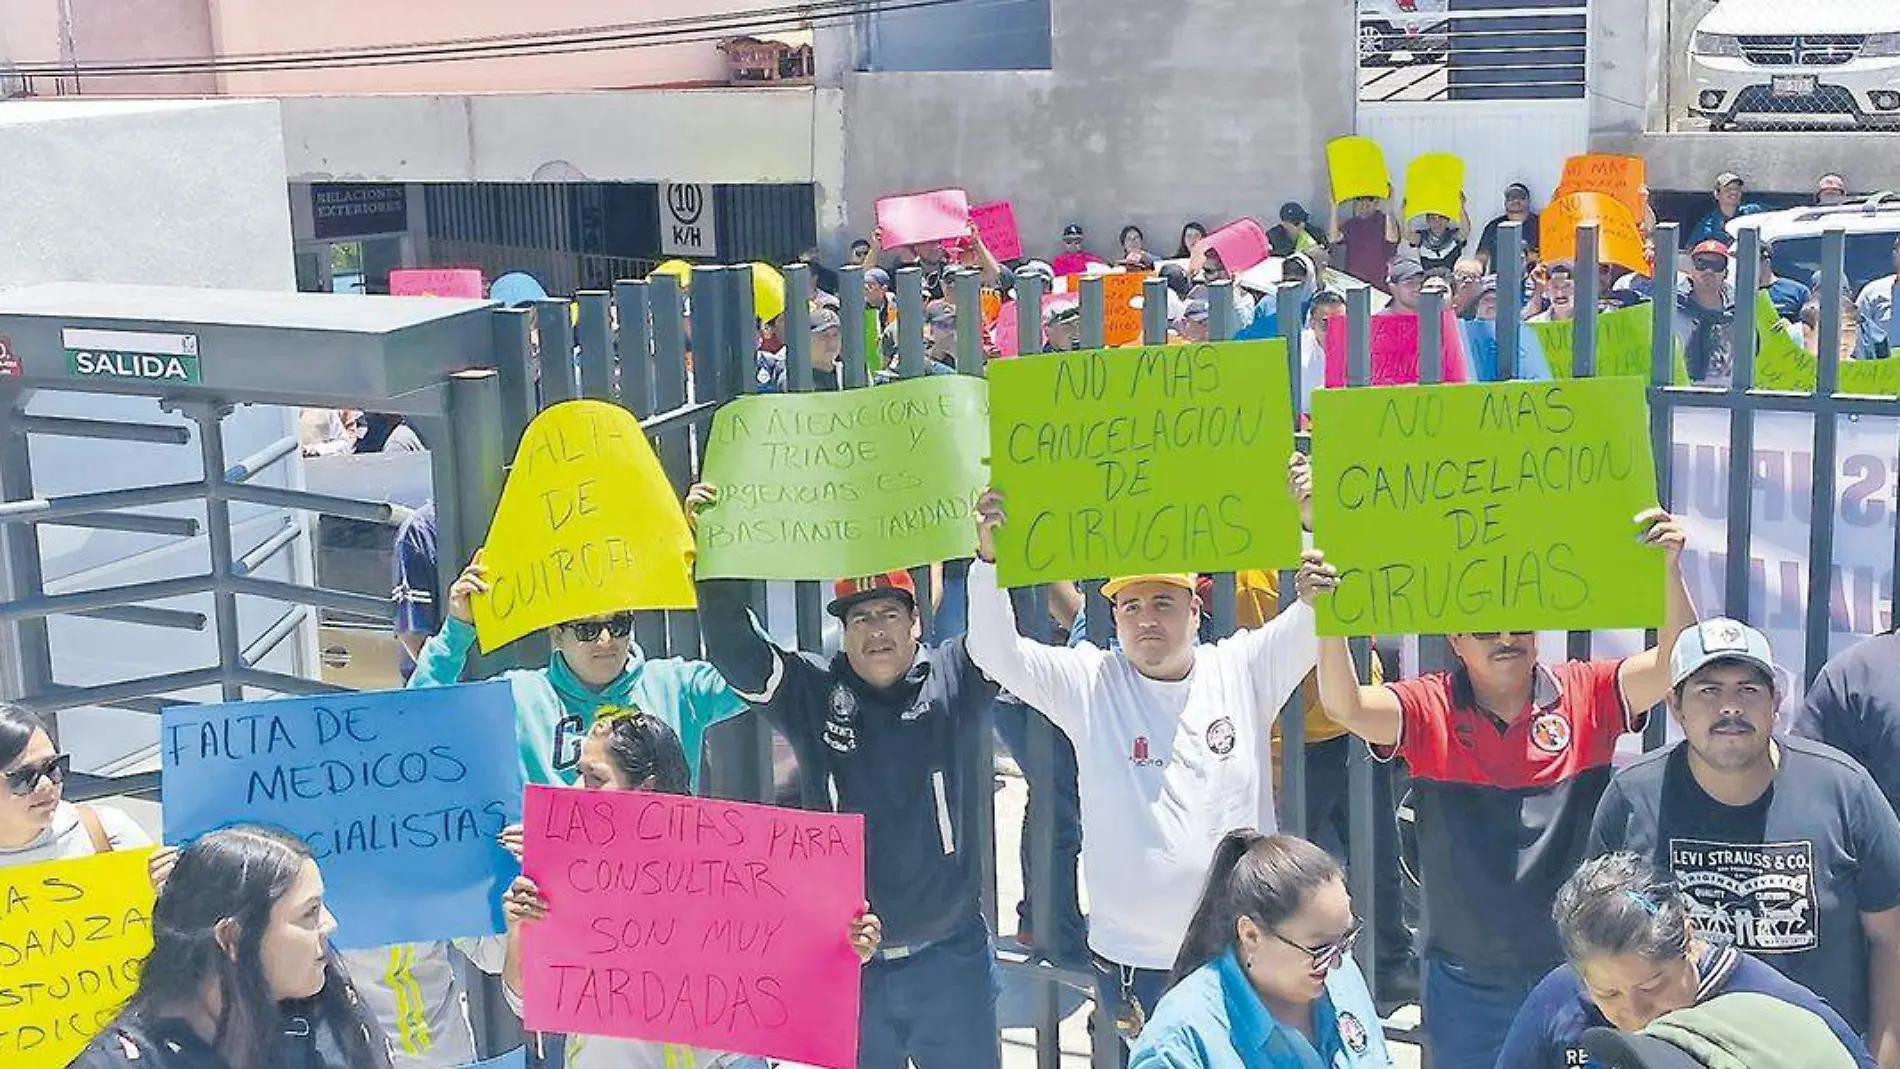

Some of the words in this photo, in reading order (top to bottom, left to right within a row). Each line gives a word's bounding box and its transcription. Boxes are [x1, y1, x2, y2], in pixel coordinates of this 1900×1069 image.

[674, 183, 694, 212] 10
[672, 225, 701, 247] K/H
[76, 351, 188, 380] SALIDA
[1053, 351, 1108, 405] NO
[1129, 344, 1222, 399] MAS
[716, 413, 751, 446] LA
[767, 398, 931, 439] ATENCION
[1008, 396, 1267, 466] CANCELACION
[1378, 394, 1445, 438] NO
[1478, 387, 1575, 433] MAS
[908, 425, 926, 452] Y
[1096, 458, 1152, 502] DE
[1337, 440, 1633, 511] CANCELACION
[539, 478, 599, 531] DE
[1443, 503, 1506, 551] DE
[707, 517, 863, 549] BASTANTE
[1025, 494, 1252, 573] CIRUGIAS
[1331, 543, 1590, 626] CIRUGIAS
[167, 714, 297, 767] FALTA
[313, 705, 379, 746] DE
[247, 745, 468, 804] MEDICOS
[304, 800, 507, 861] CIALISTAS
[544, 794, 616, 847] LAS
[636, 801, 745, 848] CITAS
[767, 817, 850, 860] PARA
[567, 857, 788, 898] CONSULTAR
[1673, 850, 1703, 868] LEVI
[1708, 850, 1772, 869] STRAUSS
[1774, 855, 1785, 870] &
[0, 877, 85, 919] AS
[586, 916, 677, 955] SON
[700, 916, 785, 956] MUY
[549, 963, 790, 1034] TARDADAS
